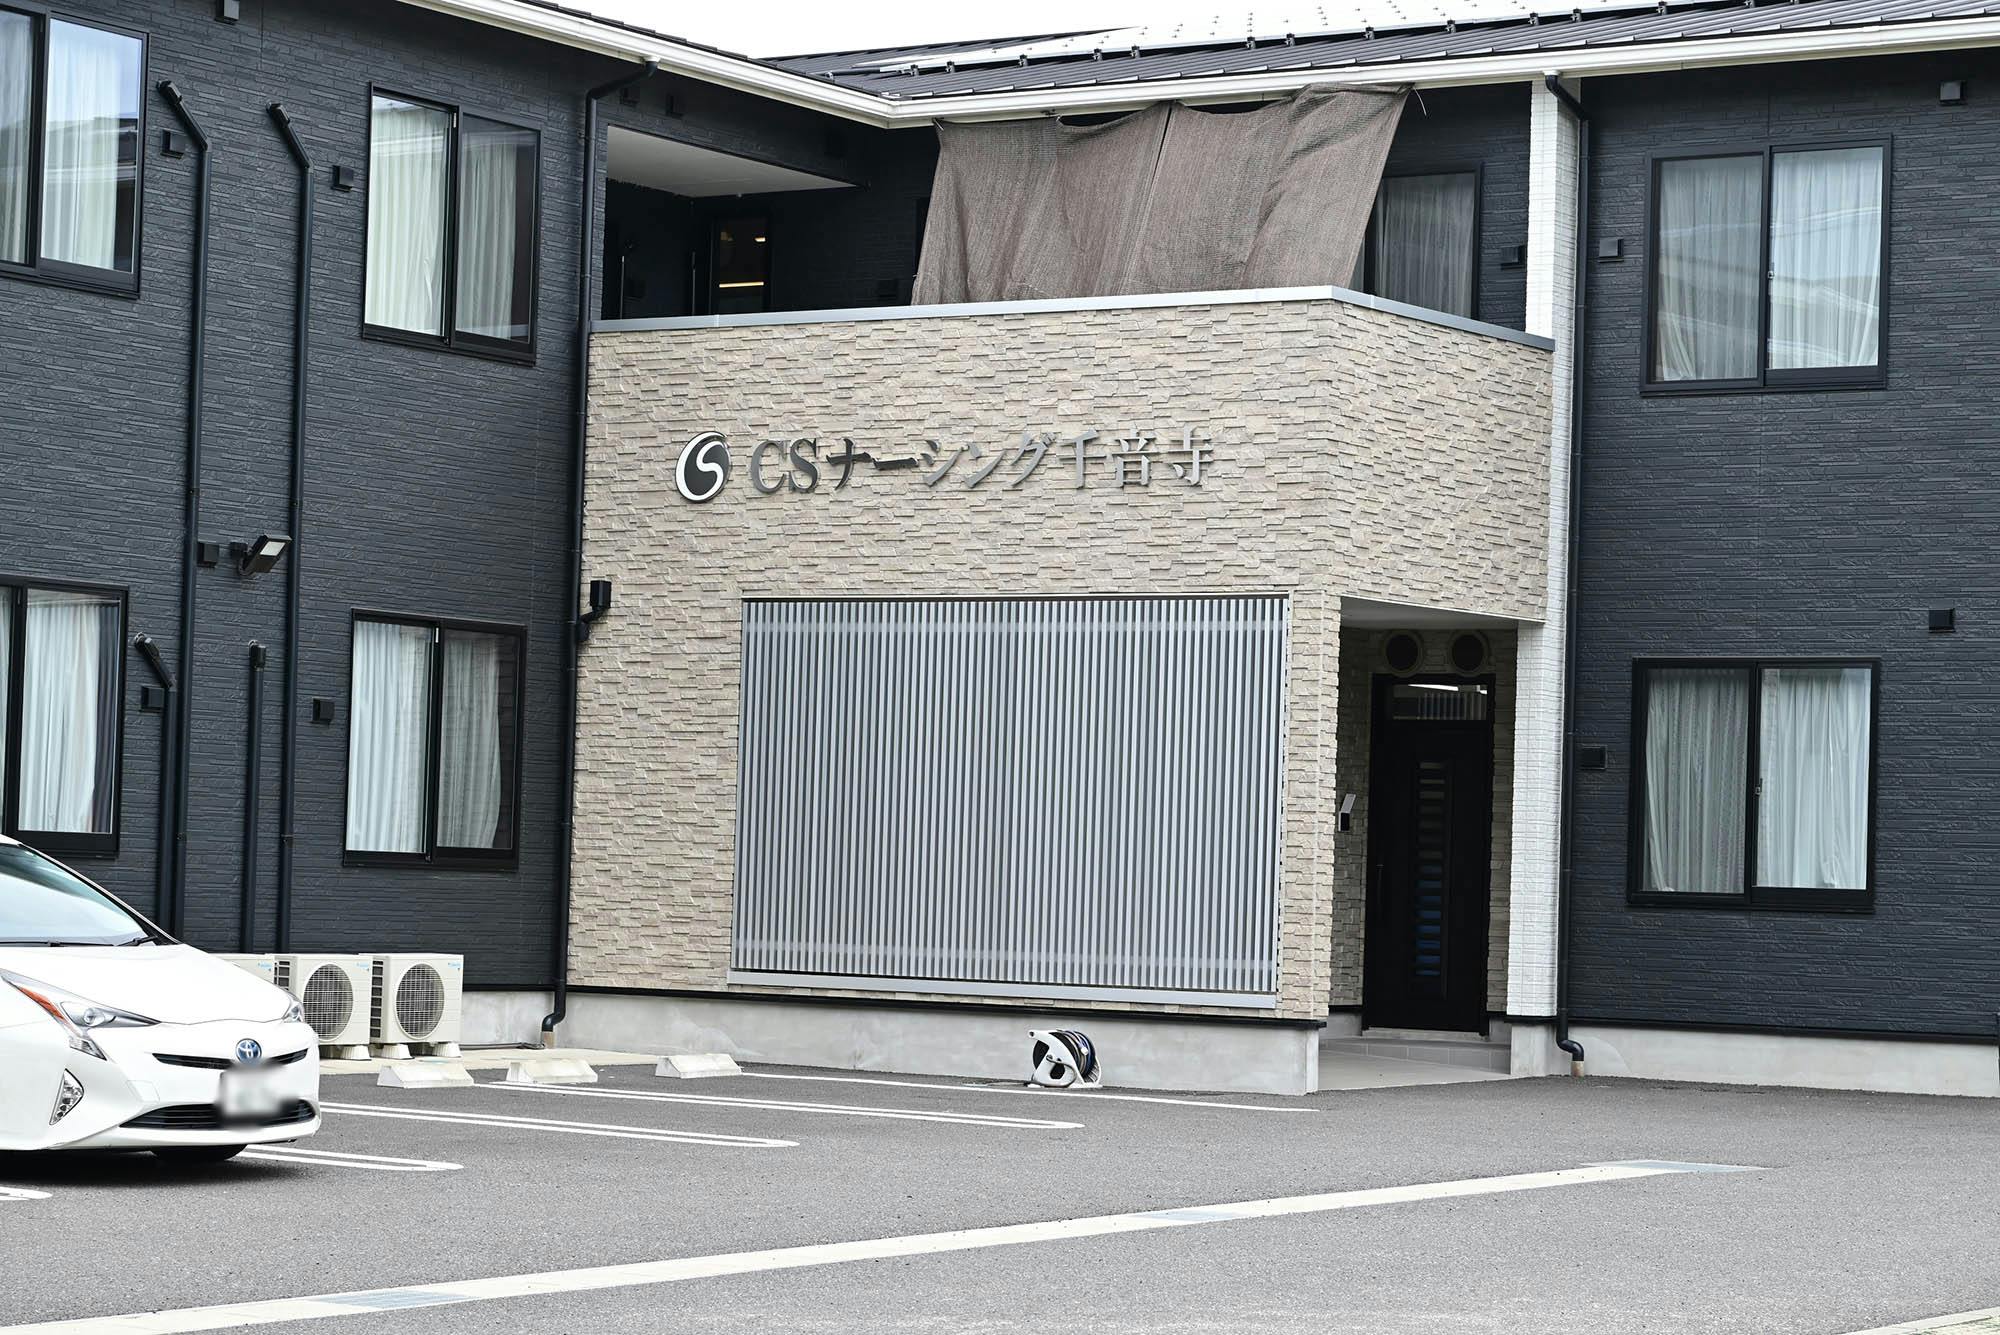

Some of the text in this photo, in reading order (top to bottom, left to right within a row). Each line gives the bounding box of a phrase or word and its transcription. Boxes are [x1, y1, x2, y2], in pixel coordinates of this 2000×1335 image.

[751, 424, 1214, 493] CSナーシング千音寺
